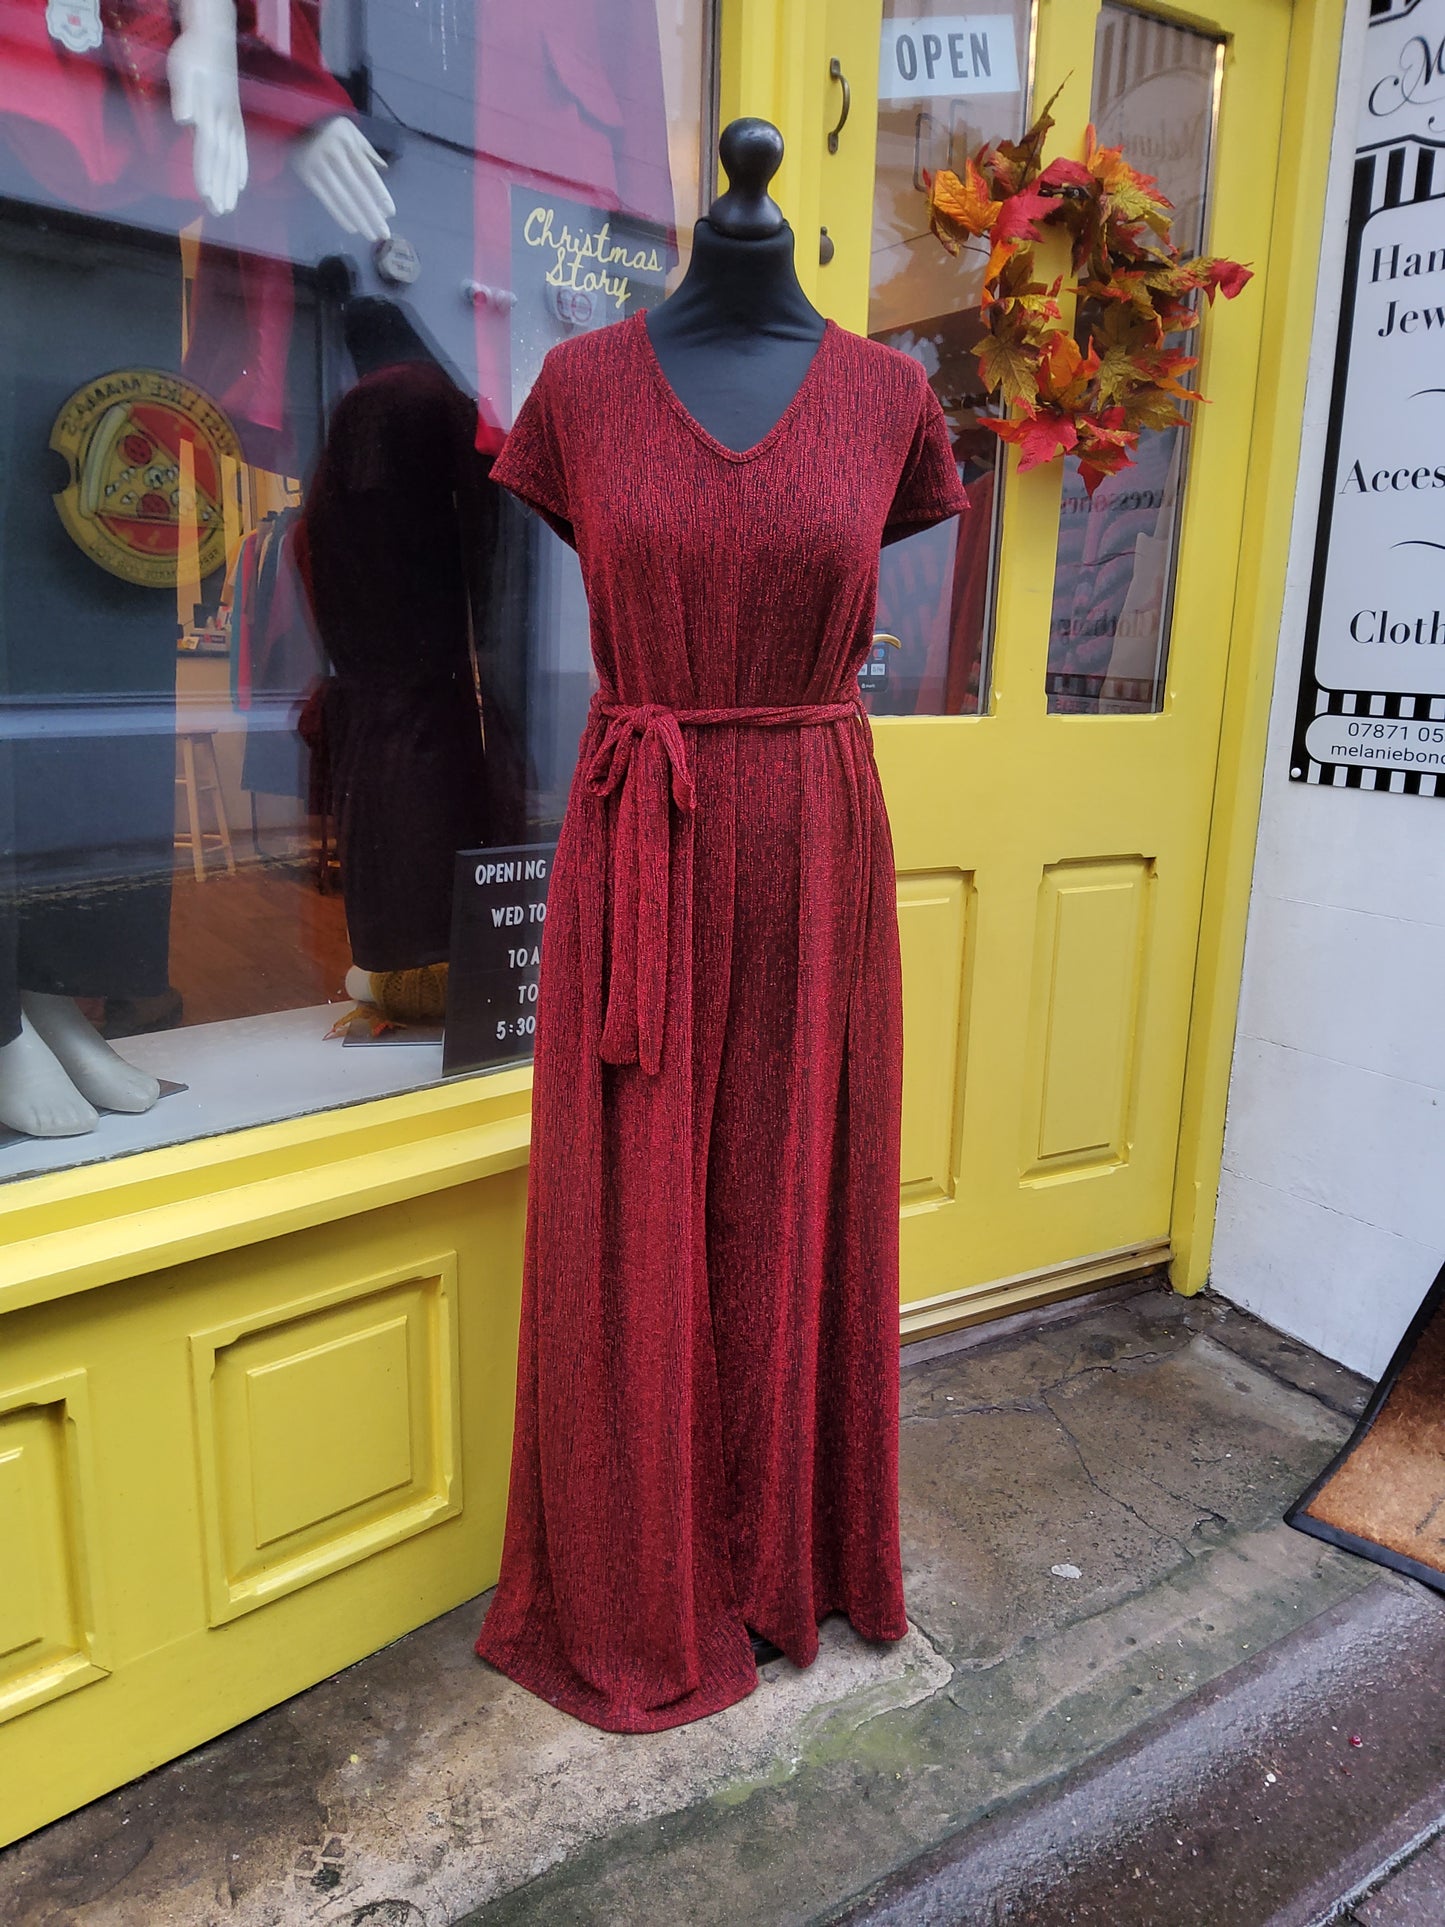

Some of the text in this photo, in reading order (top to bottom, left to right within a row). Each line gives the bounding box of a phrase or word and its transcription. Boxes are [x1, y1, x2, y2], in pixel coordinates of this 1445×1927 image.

[896, 32, 991, 81] OPEN
[524, 207, 662, 272] Christmas
[545, 247, 631, 308] Story
[1368, 243, 1445, 284] Han
[1378, 300, 1445, 337] Jew
[1339, 459, 1445, 495] Acces
[1349, 610, 1445, 645] Cloth
[1348, 722, 1408, 741] 07871
[475, 859, 546, 885] OPENING
[491, 903, 546, 928] WED TO
[518, 984, 538, 1004] TO
[496, 1015, 536, 1041] 5:30
